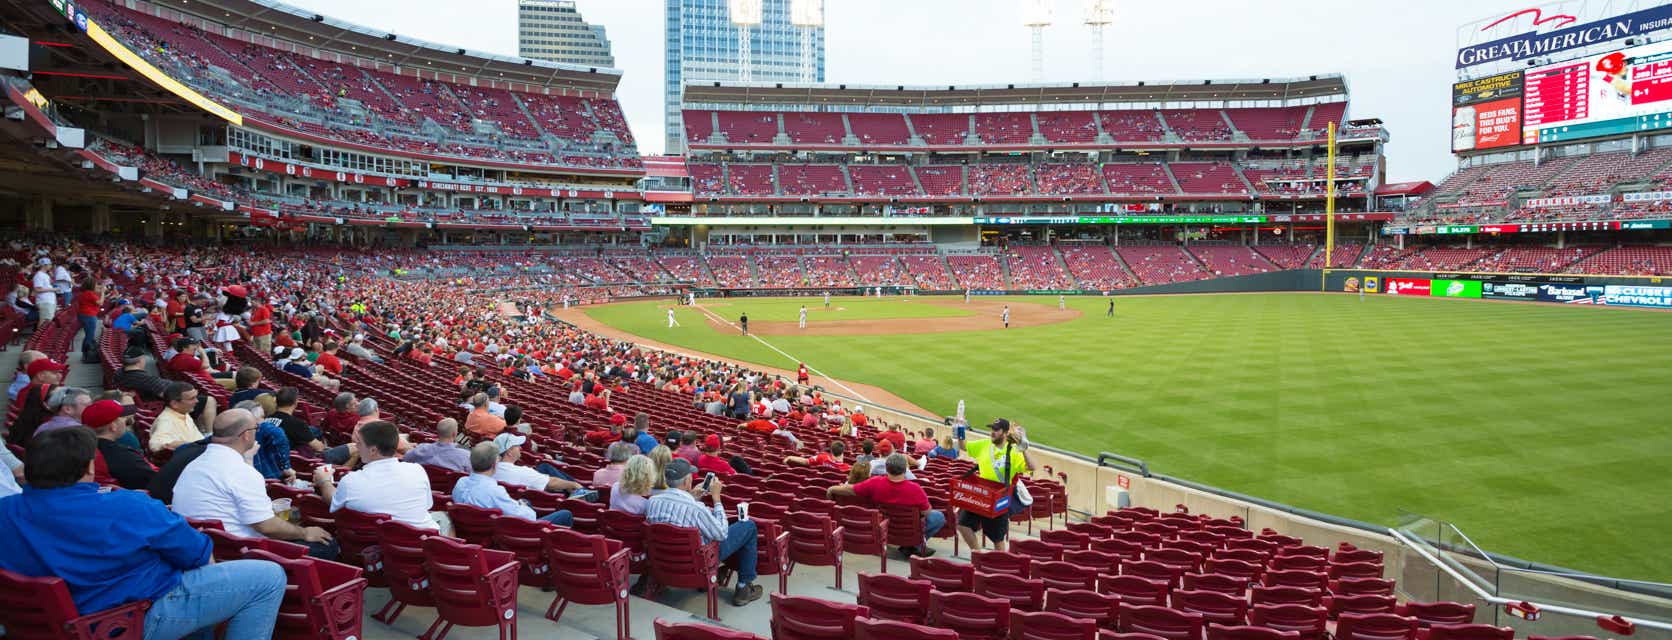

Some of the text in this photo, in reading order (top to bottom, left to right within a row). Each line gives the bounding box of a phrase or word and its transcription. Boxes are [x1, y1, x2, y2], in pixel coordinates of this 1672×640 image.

[1459, 40, 1524, 65] GREAT
[1515, 19, 1633, 58] AMERICAN
[1463, 80, 1511, 95] AUTOMOTIVE
[1480, 110, 1497, 120] REDS
[1480, 118, 1495, 127] THIS
[1479, 126, 1493, 136] FOR
